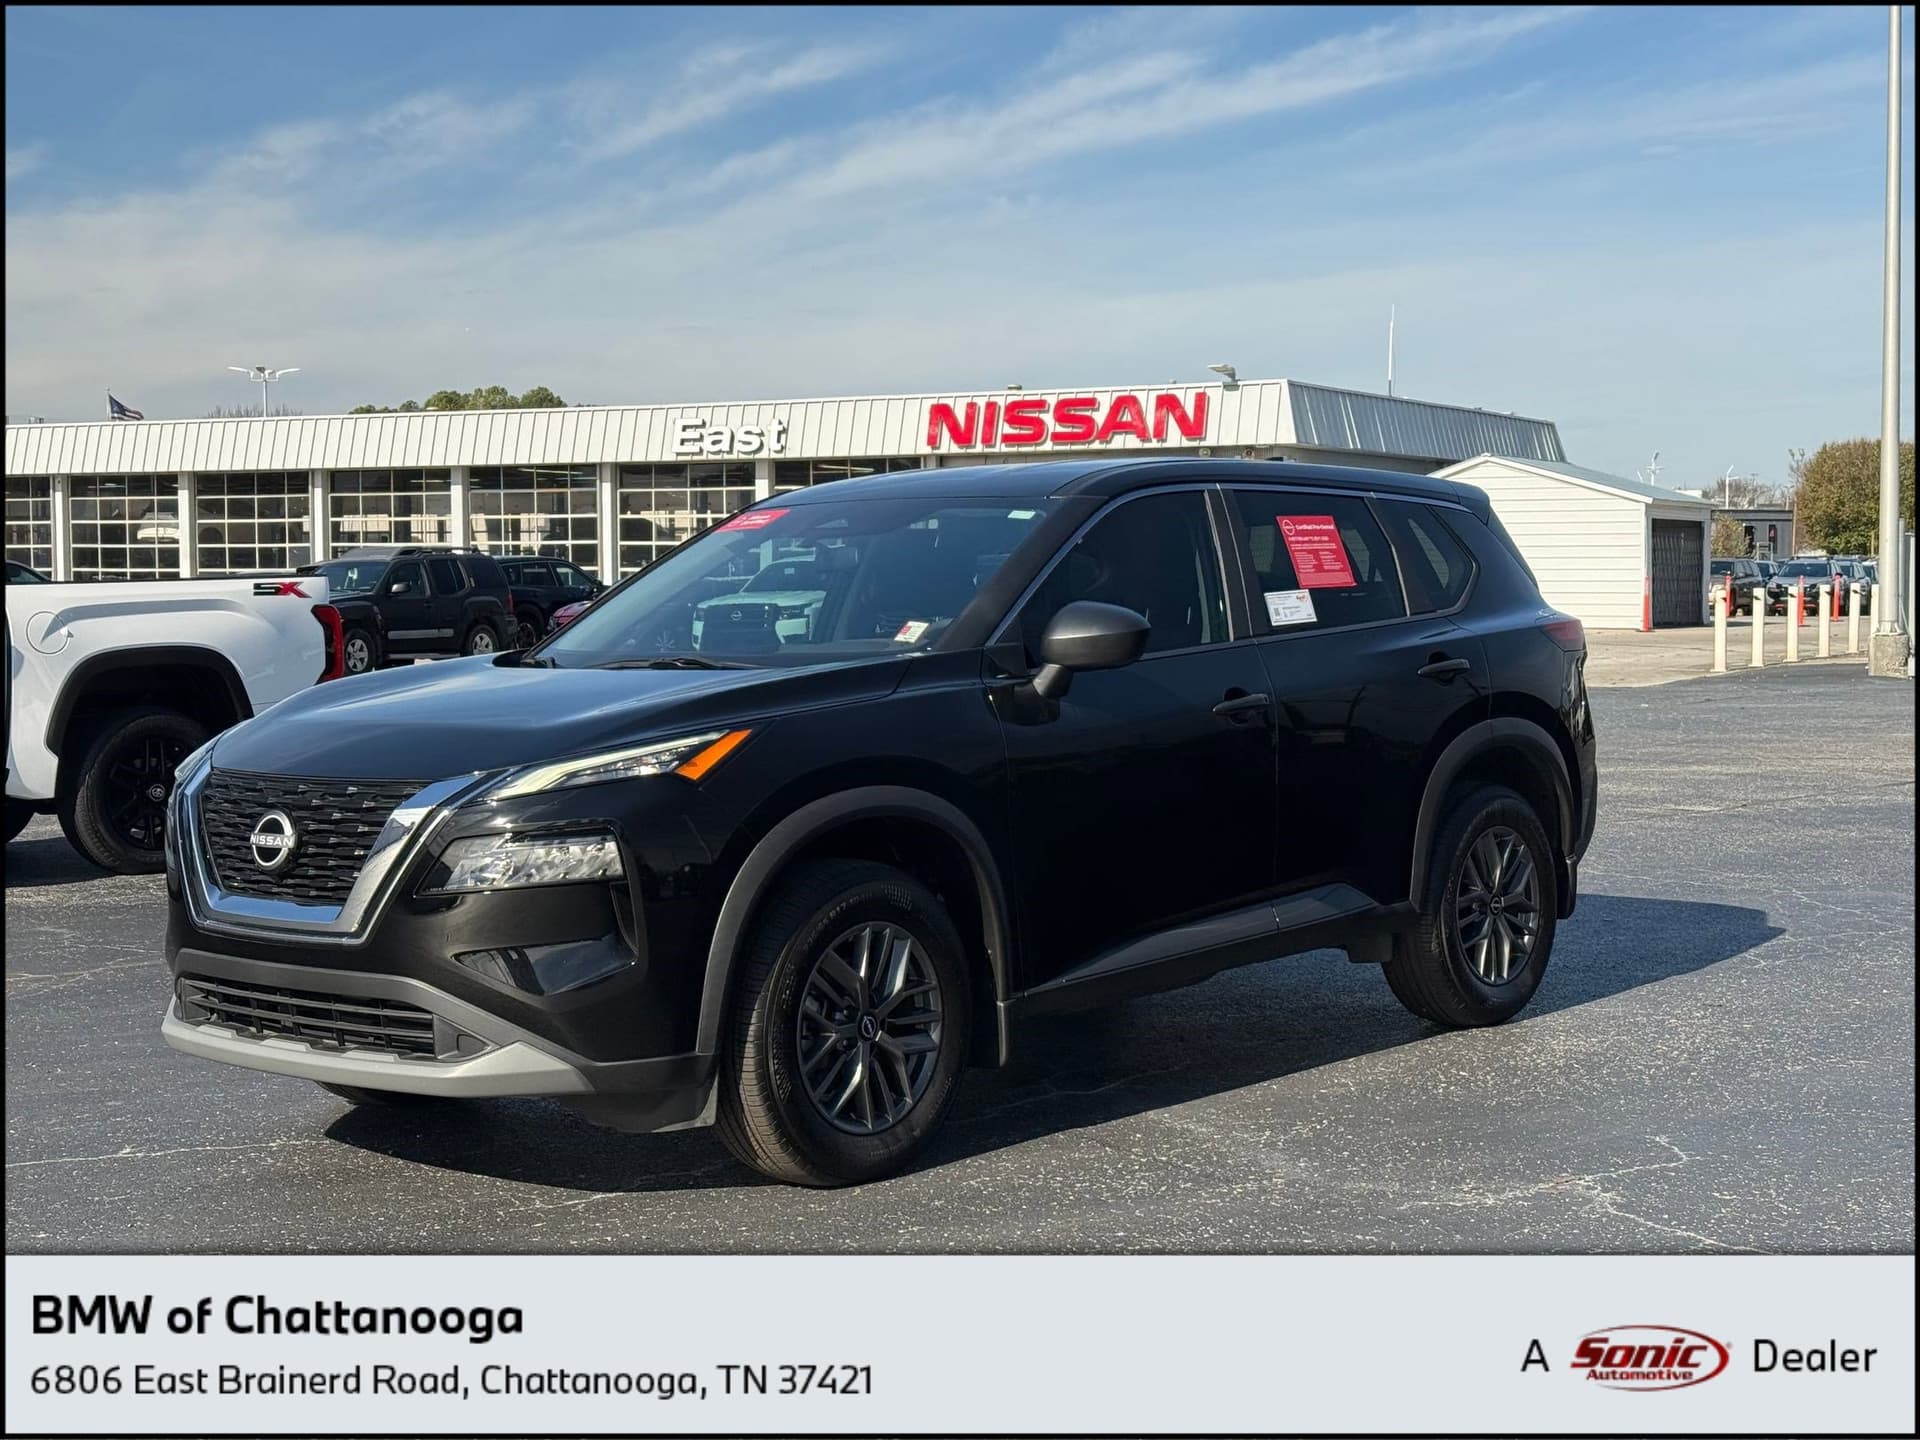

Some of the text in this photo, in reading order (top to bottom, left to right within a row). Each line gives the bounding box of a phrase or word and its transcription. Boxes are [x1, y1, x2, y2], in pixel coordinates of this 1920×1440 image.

[672, 391, 1208, 455] East NISSAN
[250, 833, 293, 846] NISSAN
